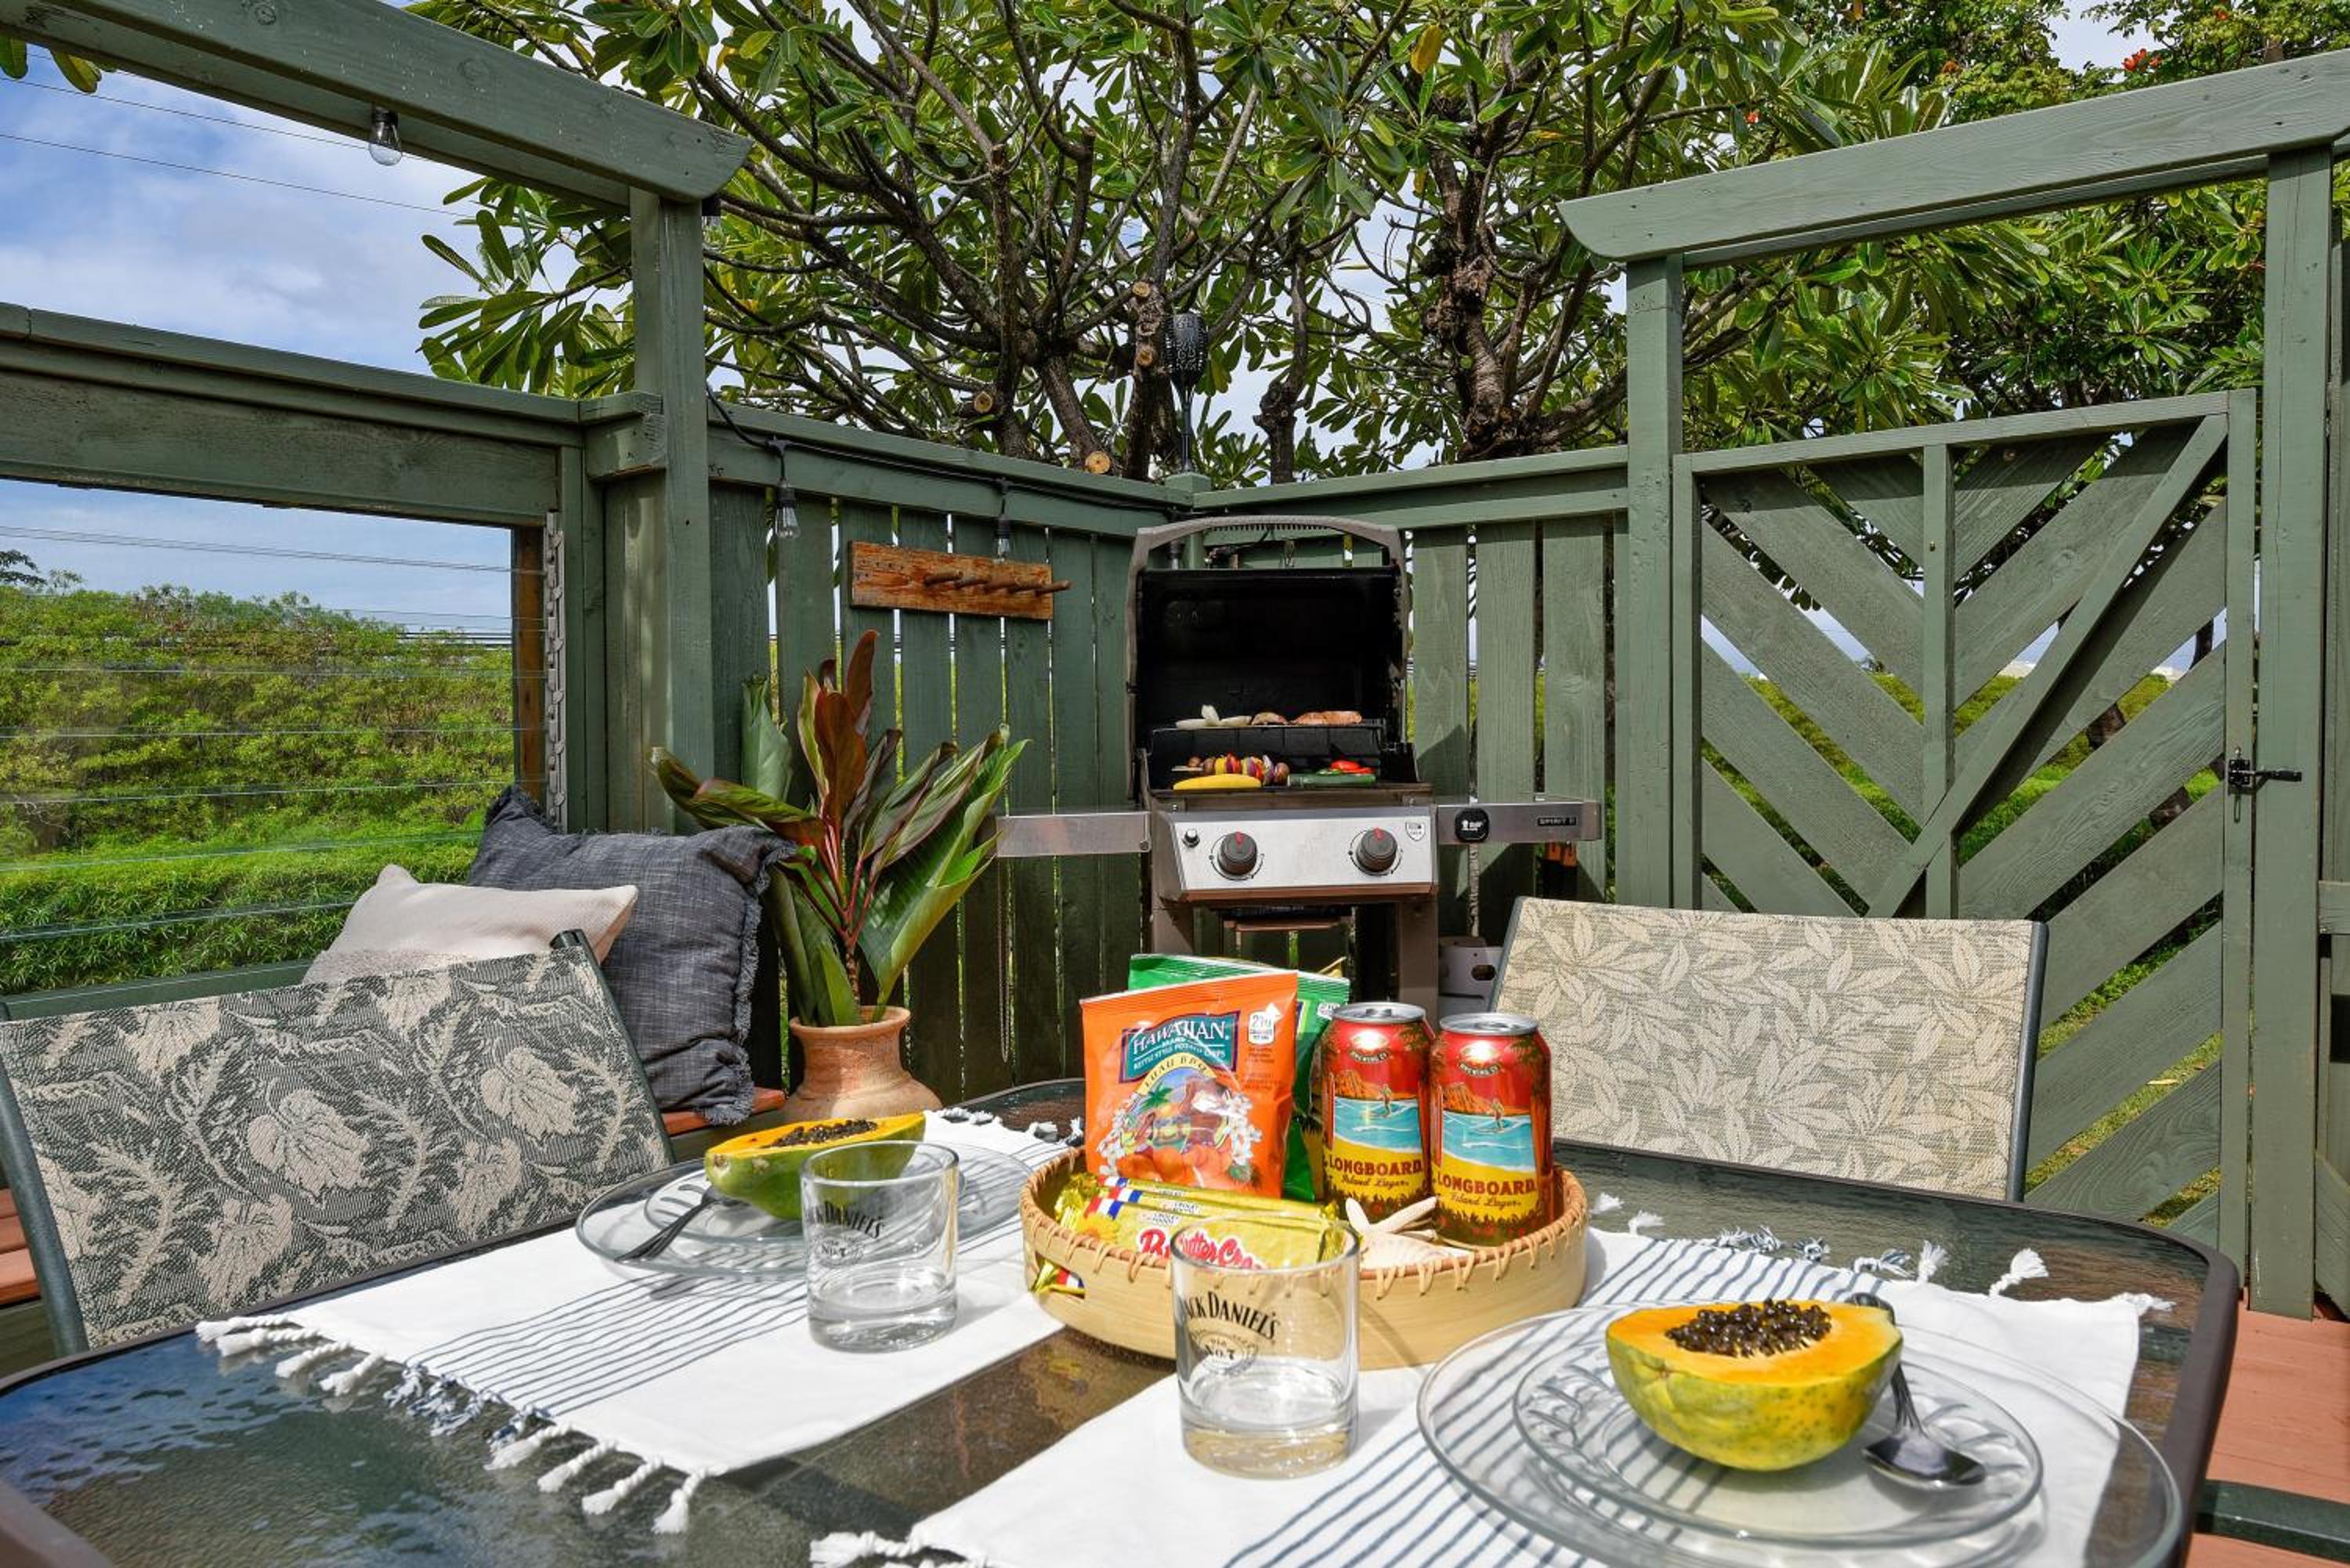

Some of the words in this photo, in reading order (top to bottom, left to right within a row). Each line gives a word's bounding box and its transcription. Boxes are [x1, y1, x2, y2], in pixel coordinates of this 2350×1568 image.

[1133, 1020, 1226, 1055] HAWAIIAN
[1329, 1154, 1423, 1176] LONGBOARD
[1342, 1174, 1372, 1187] Island
[1437, 1172, 1536, 1196] LONGBOARD
[1452, 1193, 1480, 1205] Island
[1207, 1291, 1281, 1340] DANIEL'S
